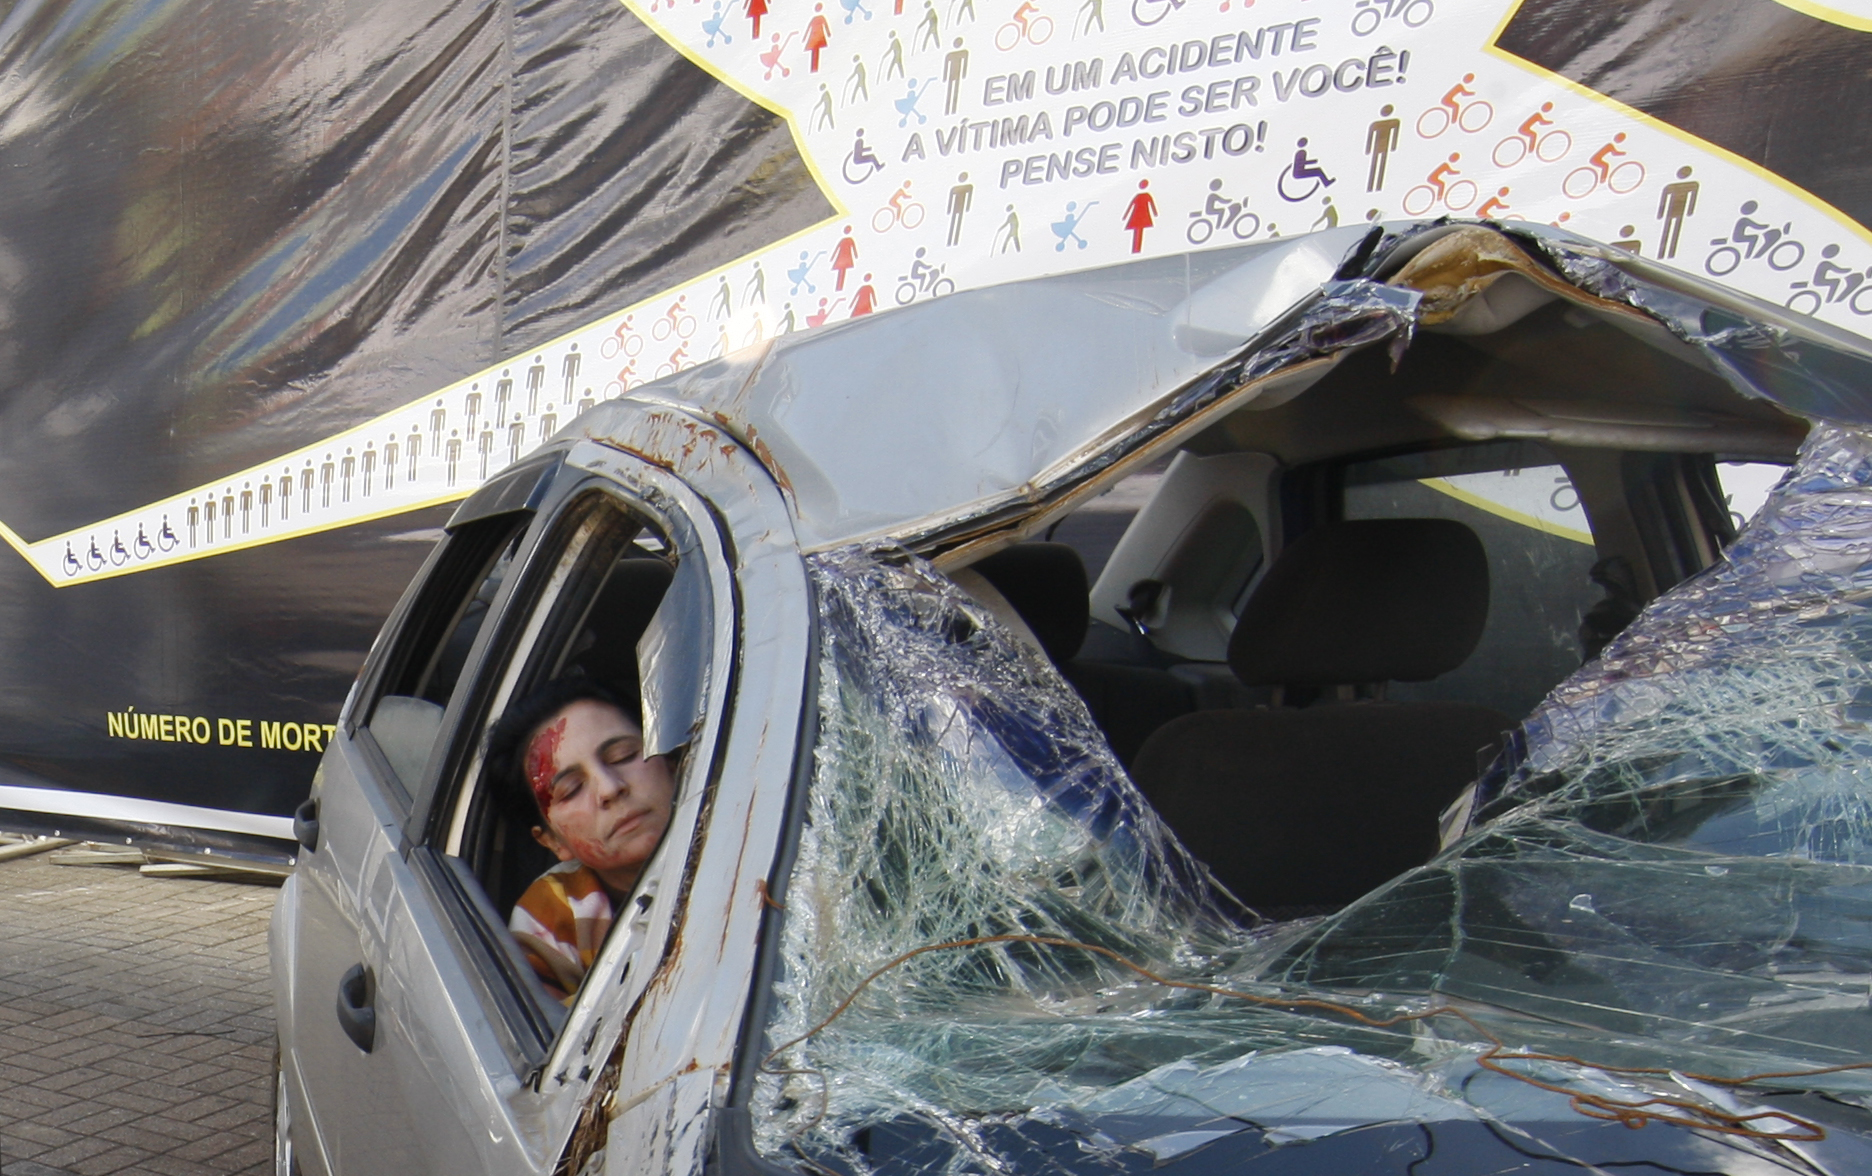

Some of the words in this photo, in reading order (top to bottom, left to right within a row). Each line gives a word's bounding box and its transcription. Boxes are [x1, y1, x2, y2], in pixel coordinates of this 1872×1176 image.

[984, 70, 1035, 107] EM
[1046, 57, 1103, 96] UM
[1110, 17, 1322, 86] ACIDENTE
[902, 132, 926, 163] A
[935, 110, 1053, 157] VÍTIMA
[1064, 90, 1171, 138] PODE
[1177, 75, 1261, 119] SER
[1272, 45, 1411, 103] VOCÊ!
[999, 142, 1123, 189] PENSE
[1129, 120, 1269, 170] NISTO!
[107, 706, 211, 744] NÚMERO
[218, 718, 253, 747] DE
